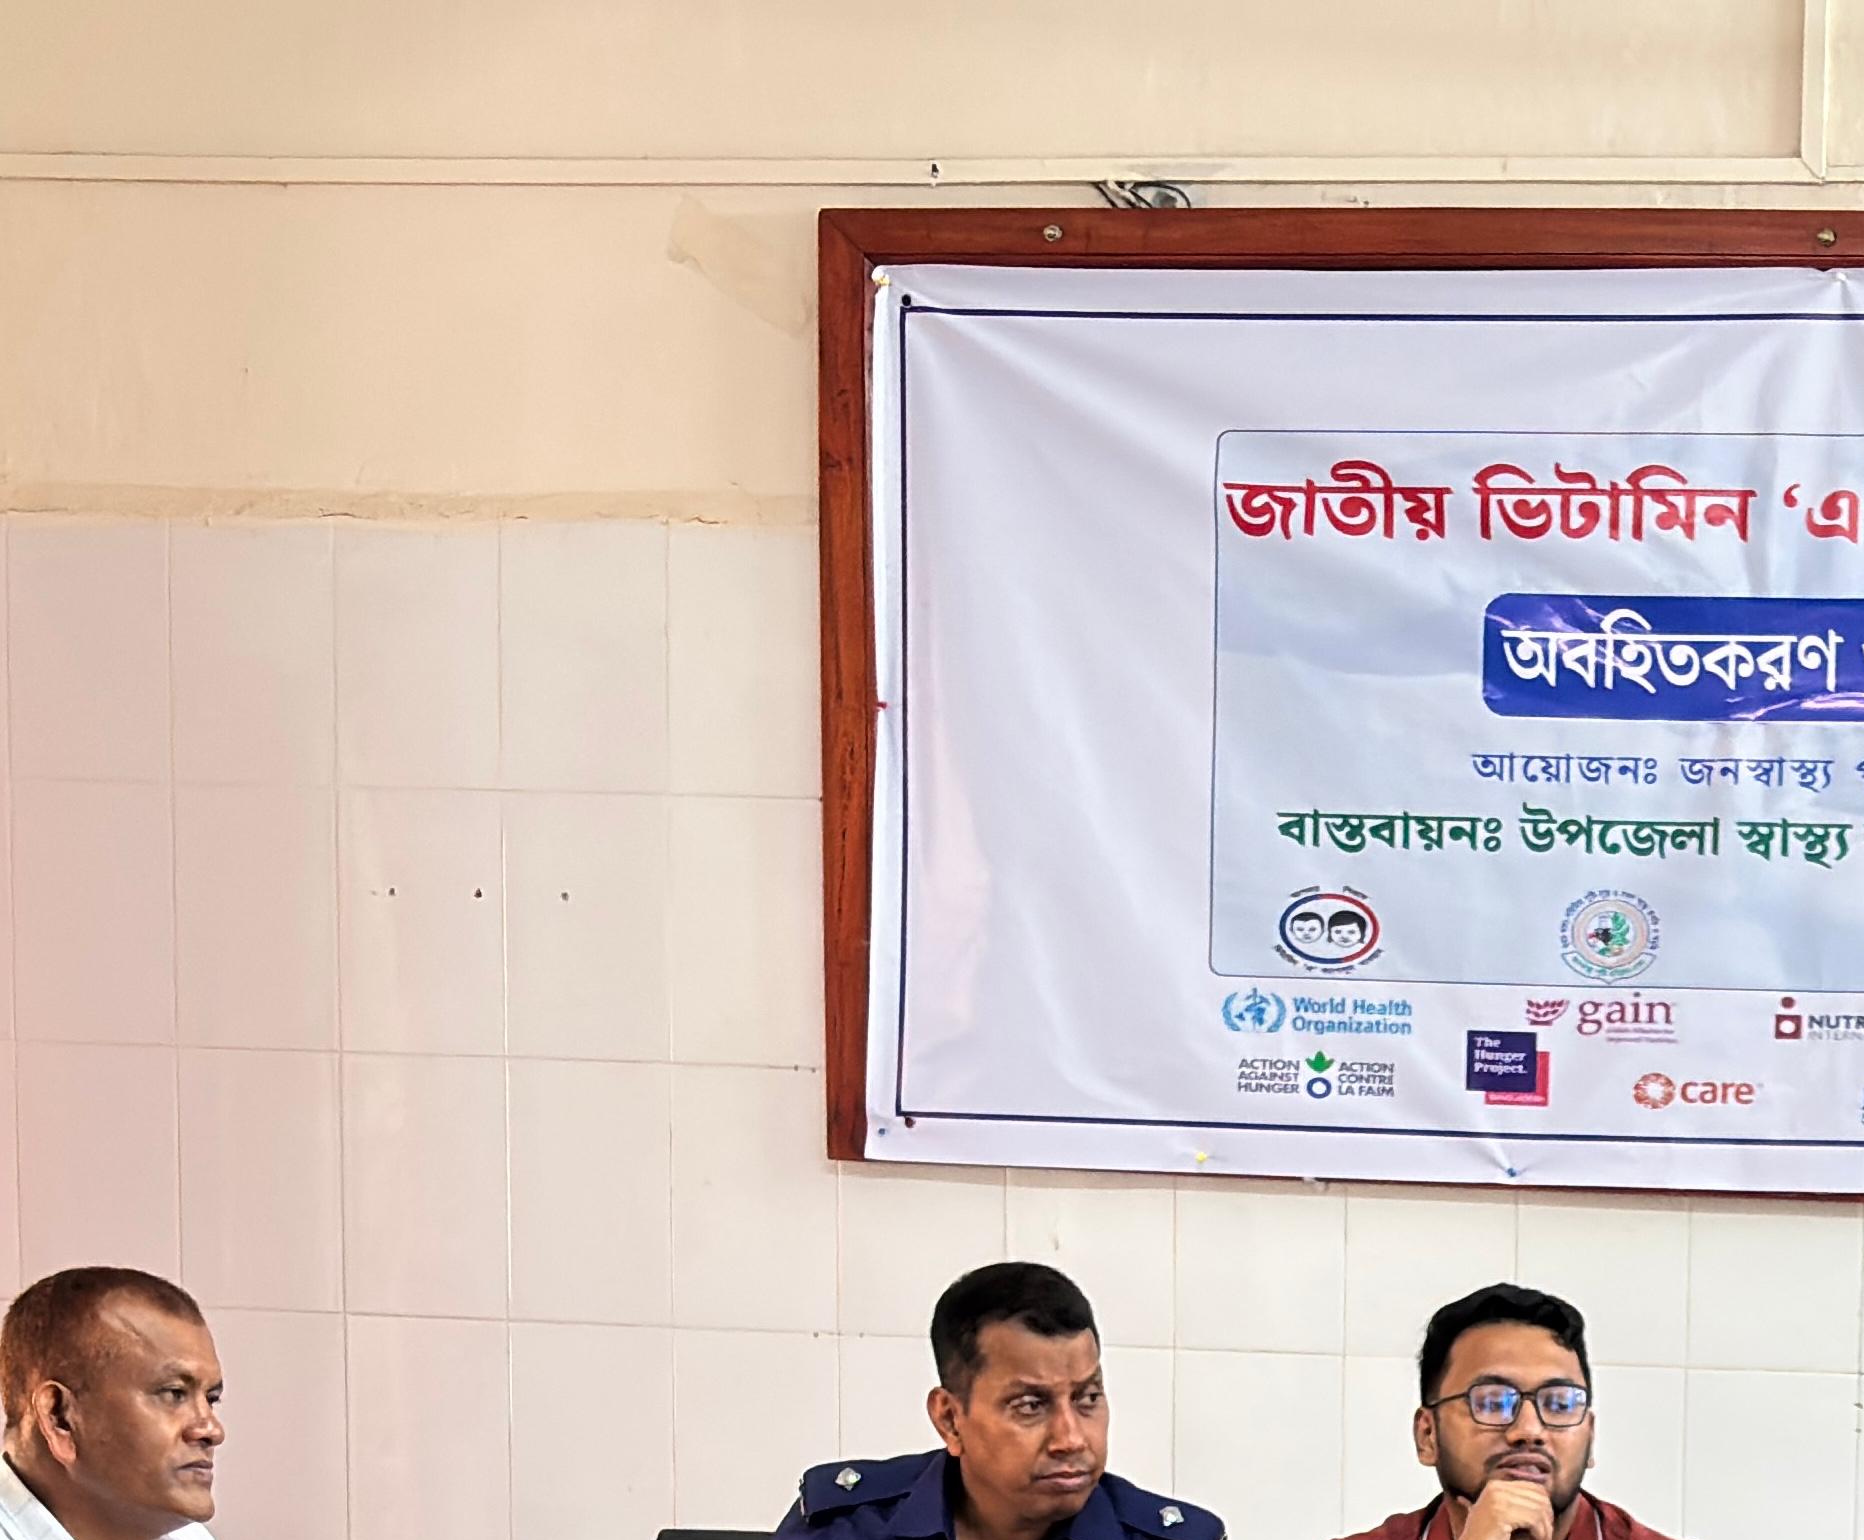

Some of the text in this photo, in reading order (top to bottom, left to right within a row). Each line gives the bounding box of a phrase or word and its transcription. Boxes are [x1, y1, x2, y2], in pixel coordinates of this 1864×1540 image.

[1223, 460, 1451, 541] জাতীয়
[1471, 463, 1757, 543] ভিটামিন
[1501, 609, 1843, 694] অবহিতকরণ
[1472, 752, 1657, 787] আয়োজনঃ
[1680, 756, 1834, 793] জনস্বাস্থ্য
[1276, 808, 1502, 854] বাস্তবায়নঃ
[1519, 802, 1720, 858] উপজেলা
[1737, 820, 1852, 868] স্বাস্থ্য
[1292, 997, 1412, 1016] World Health
[1577, 991, 1673, 1036] gain
[1292, 1016, 1412, 1035] Organization
[1474, 1036, 1502, 1049] The
[1238, 1058, 1300, 1072] ACTION
[1474, 1050, 1528, 1064] Hunger
[1238, 1071, 1299, 1083] AGAINST
[1337, 1062, 1395, 1073] ACTION
[1237, 1082, 1300, 1094] HUNGER
[1337, 1085, 1355, 1096] LA
[1681, 1079, 1756, 1106] care
